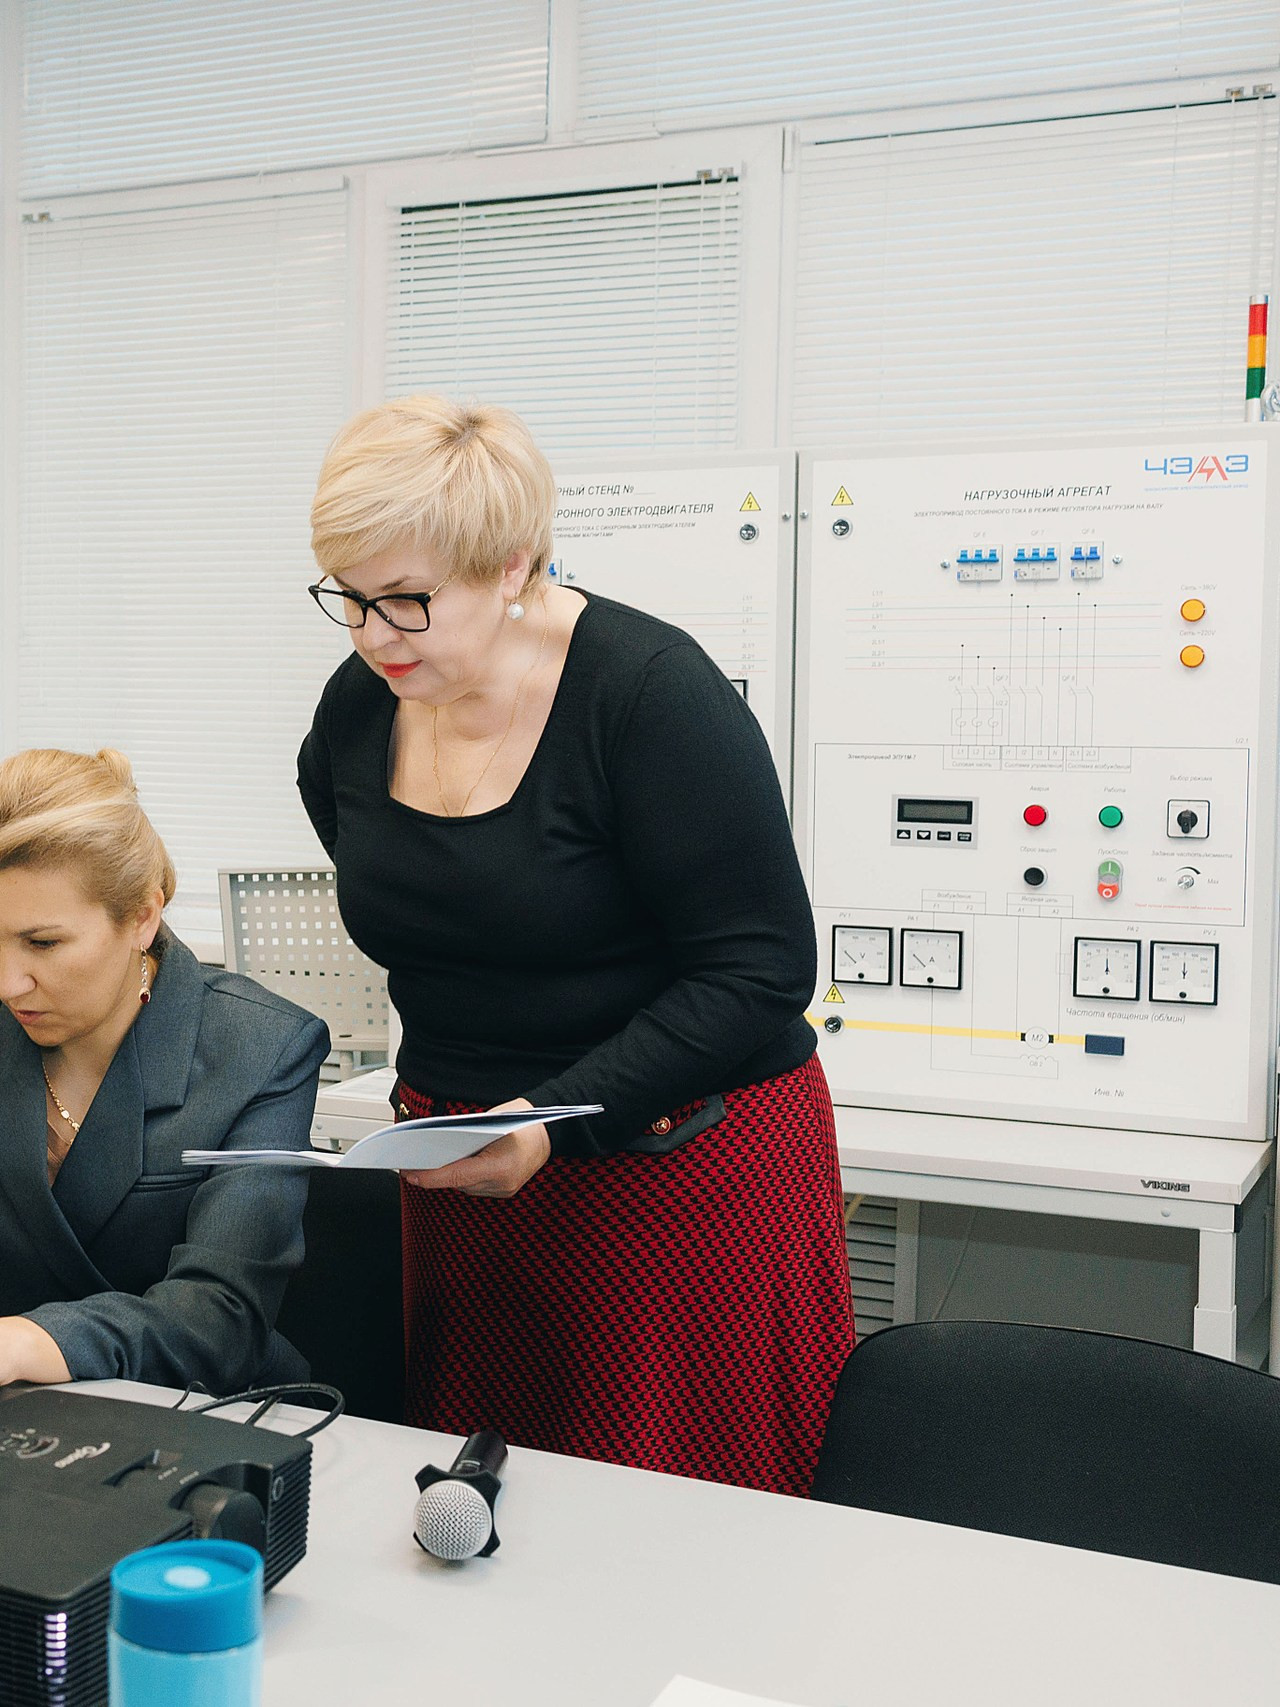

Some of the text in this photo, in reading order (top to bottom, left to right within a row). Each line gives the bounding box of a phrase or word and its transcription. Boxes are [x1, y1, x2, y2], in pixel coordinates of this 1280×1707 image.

[588, 485, 621, 496] СТЕНД
[964, 485, 1112, 501] НАГРУЗОЧНЫЙ АГРЕГАТ
[607, 504, 714, 517] ЭЛЕКТРОДВИГАТЕЛЯ
[1034, 506, 1060, 514] РЕЖИМЕ
[1102, 504, 1135, 512] НАГРУЗКИ
[1066, 1007, 1186, 1024] Частота вращения (об/мин)
[1140, 1179, 1190, 1192] VIKING
